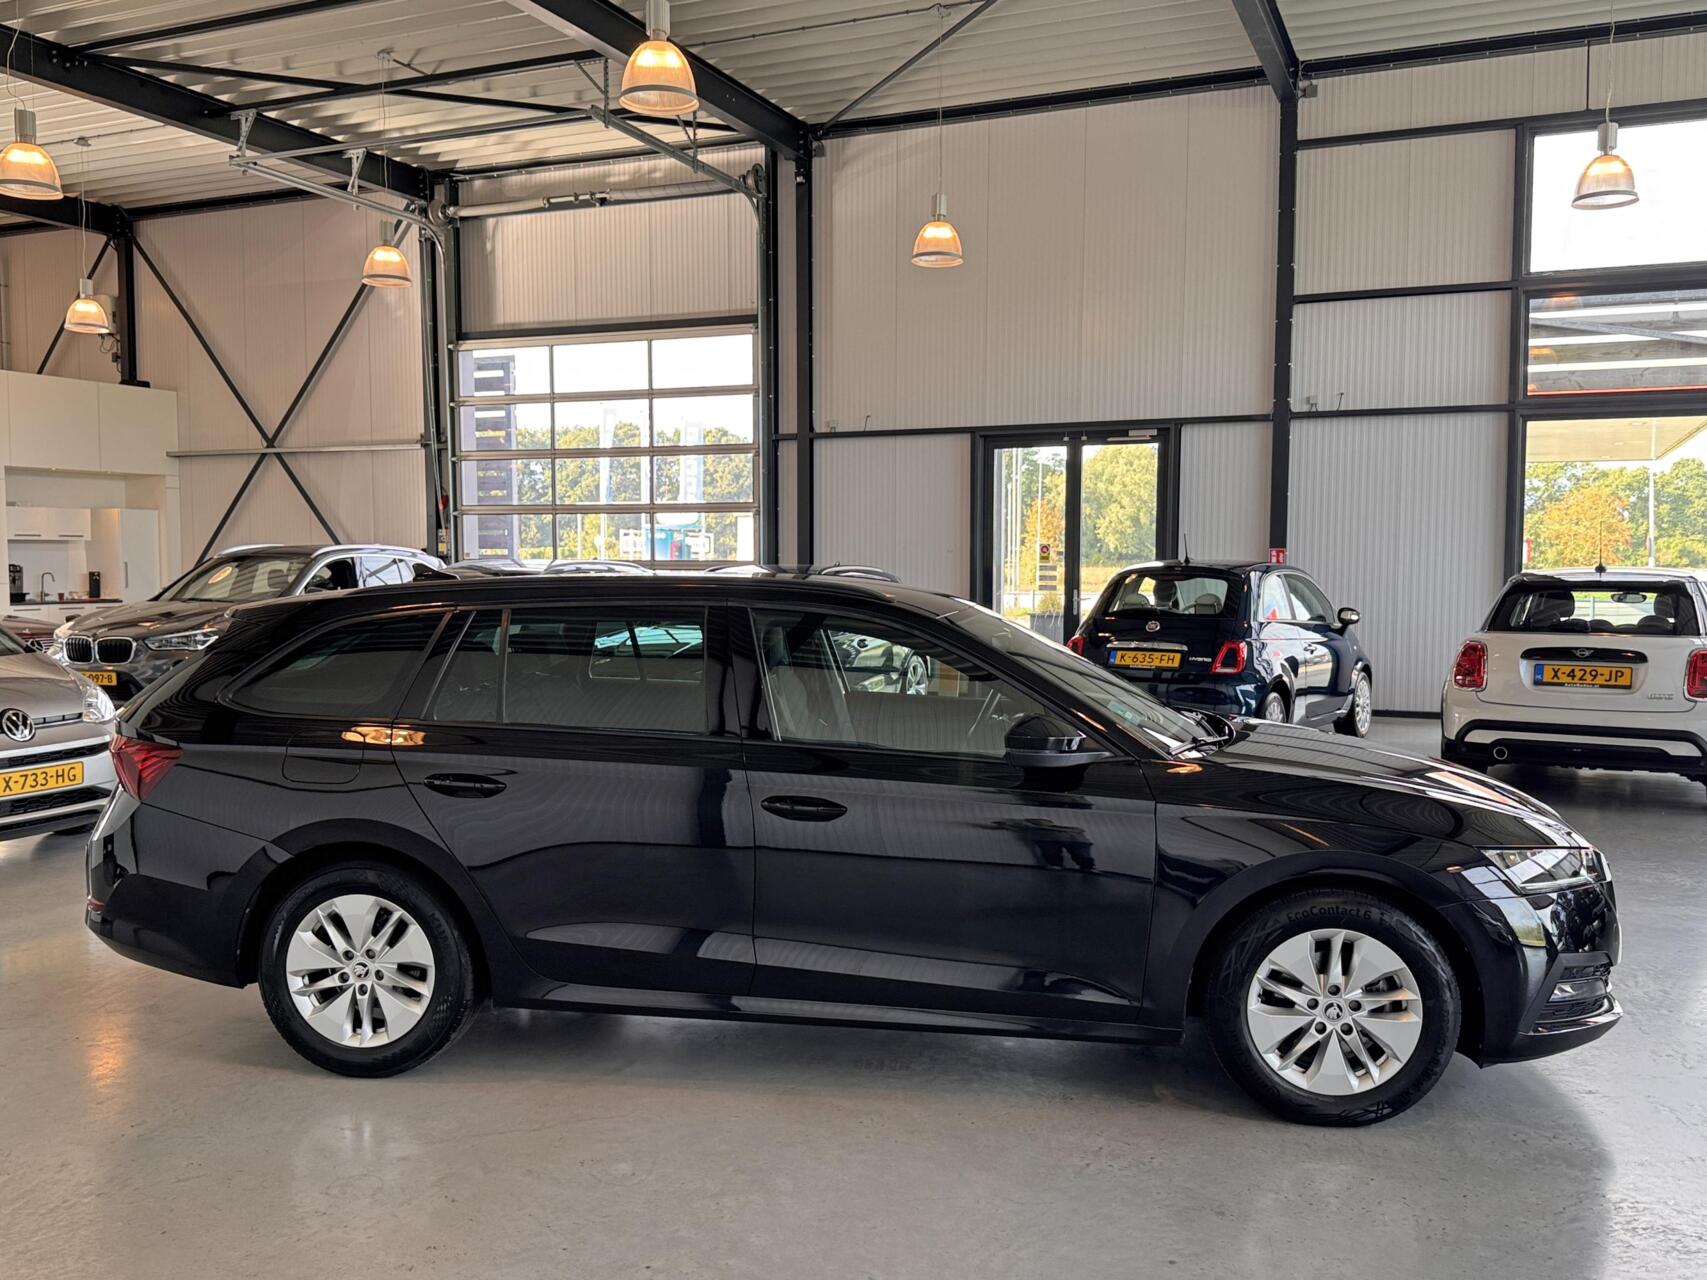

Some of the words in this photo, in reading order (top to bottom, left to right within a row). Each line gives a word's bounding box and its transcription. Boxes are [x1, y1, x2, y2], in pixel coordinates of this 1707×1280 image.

[1119, 652, 1175, 665] K-635-FH
[1551, 667, 1625, 682] X-429-JP
[2, 766, 77, 793] X-733-HG
